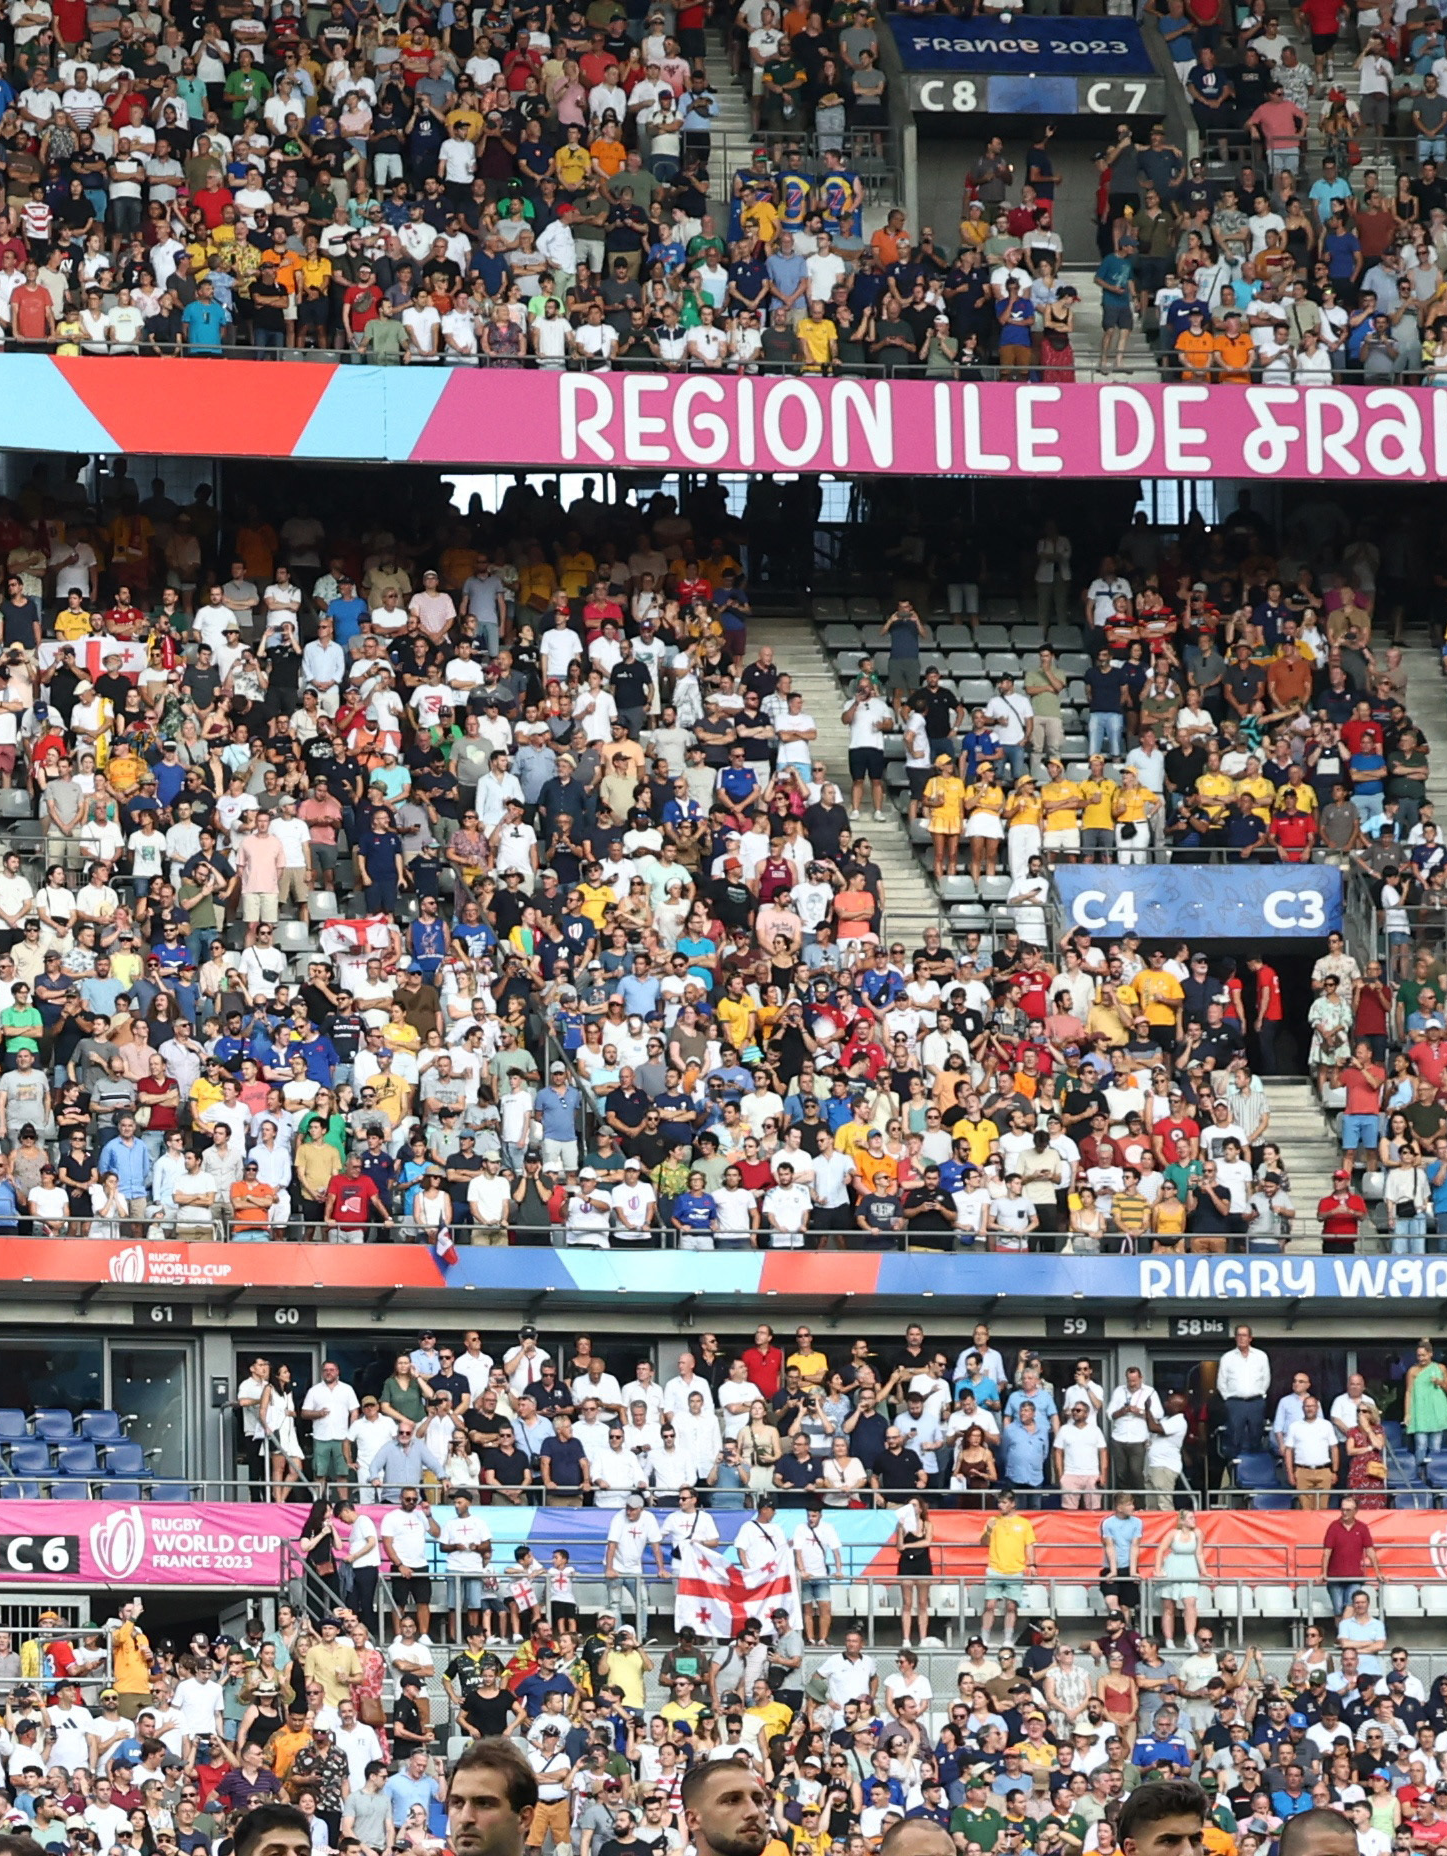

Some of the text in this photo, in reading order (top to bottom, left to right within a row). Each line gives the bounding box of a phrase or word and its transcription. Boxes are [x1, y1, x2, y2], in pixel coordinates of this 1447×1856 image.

[1052, 40, 1130, 56] 2023
[559, 373, 894, 468] REGION
[934, 377, 1064, 474] ILE
[1099, 386, 1212, 471] DE
[1071, 891, 1139, 929] C4
[1263, 890, 1325, 929] C3
[148, 1253, 182, 1264] RUGBY
[148, 1261, 232, 1276] WORLD CUP
[1140, 1258, 1316, 1298] RUGBY
[150, 1305, 173, 1322] 61
[274, 1307, 300, 1325] 60
[1063, 1318, 1088, 1335] 59
[1176, 1319, 1224, 1335] 58 bis
[151, 1518, 203, 1532] RUGBY
[152, 1534, 281, 1553] WORLD CUP
[152, 1554, 253, 1569] FRANCE 2023
